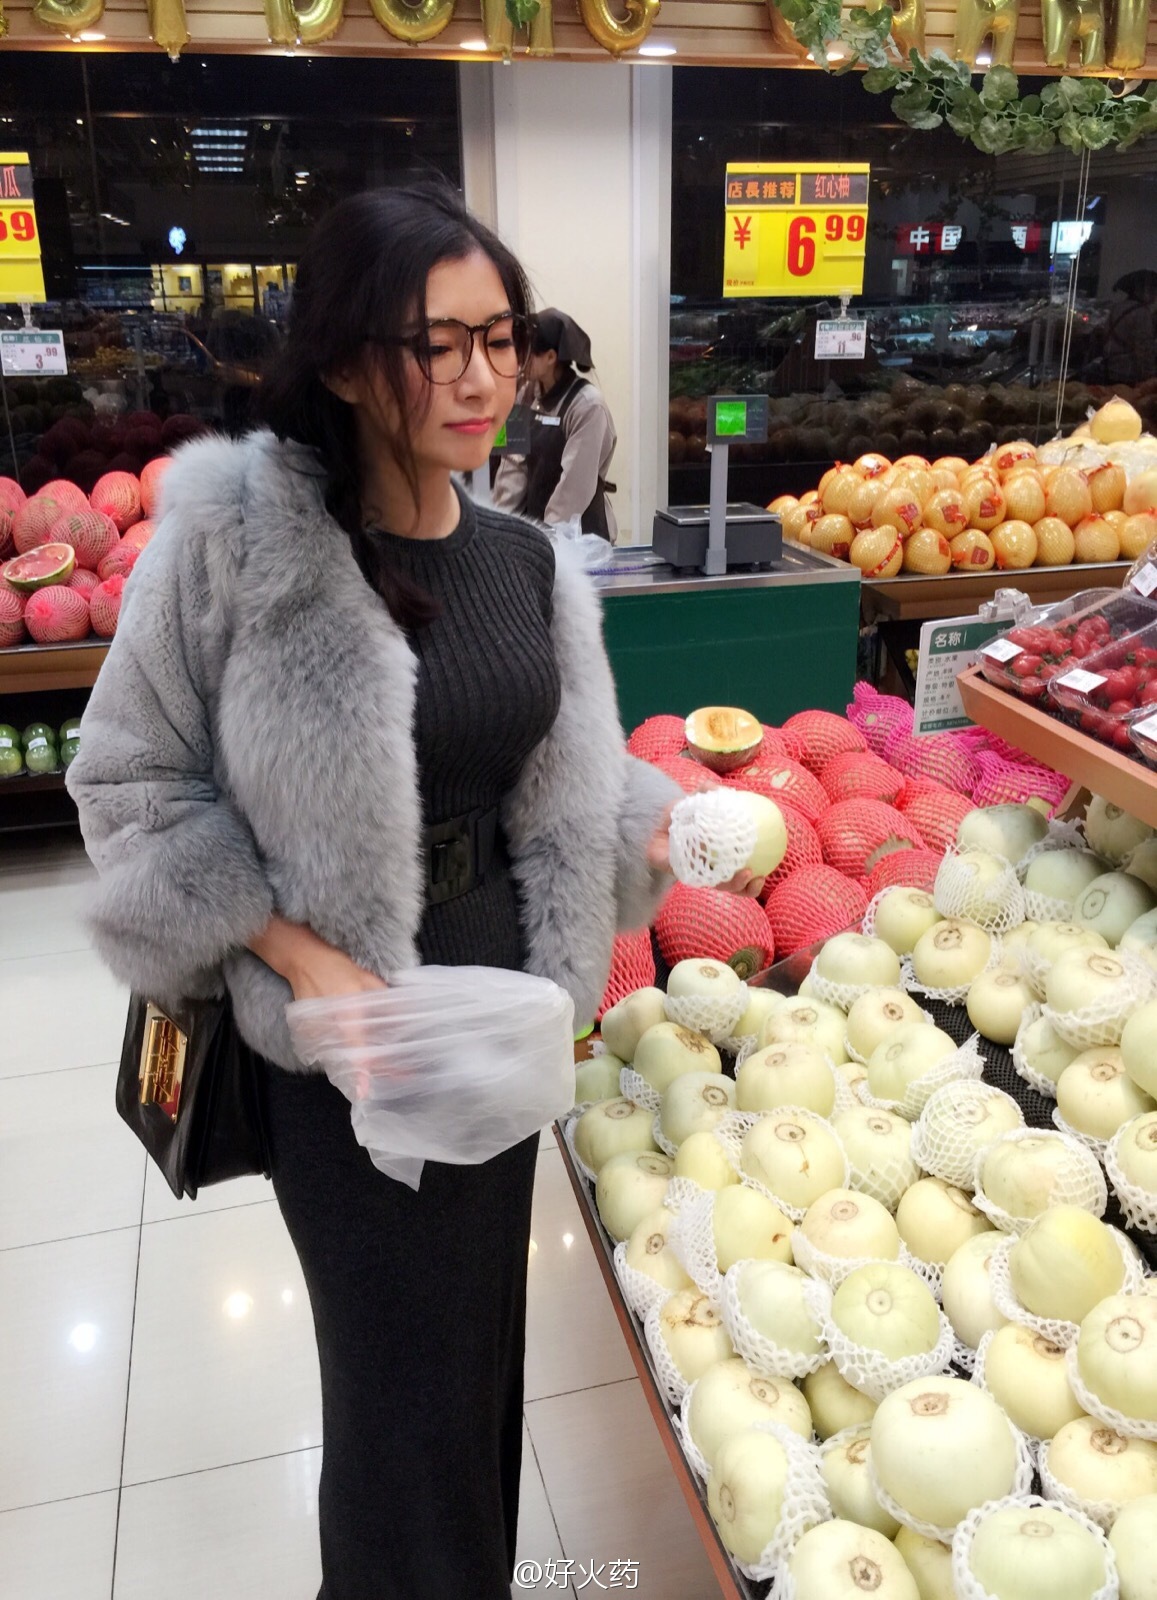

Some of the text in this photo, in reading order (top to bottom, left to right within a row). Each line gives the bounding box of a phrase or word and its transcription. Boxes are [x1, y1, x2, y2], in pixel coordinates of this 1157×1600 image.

[814, 173, 851, 199] 红心柚
[934, 631, 962, 648] 名称
